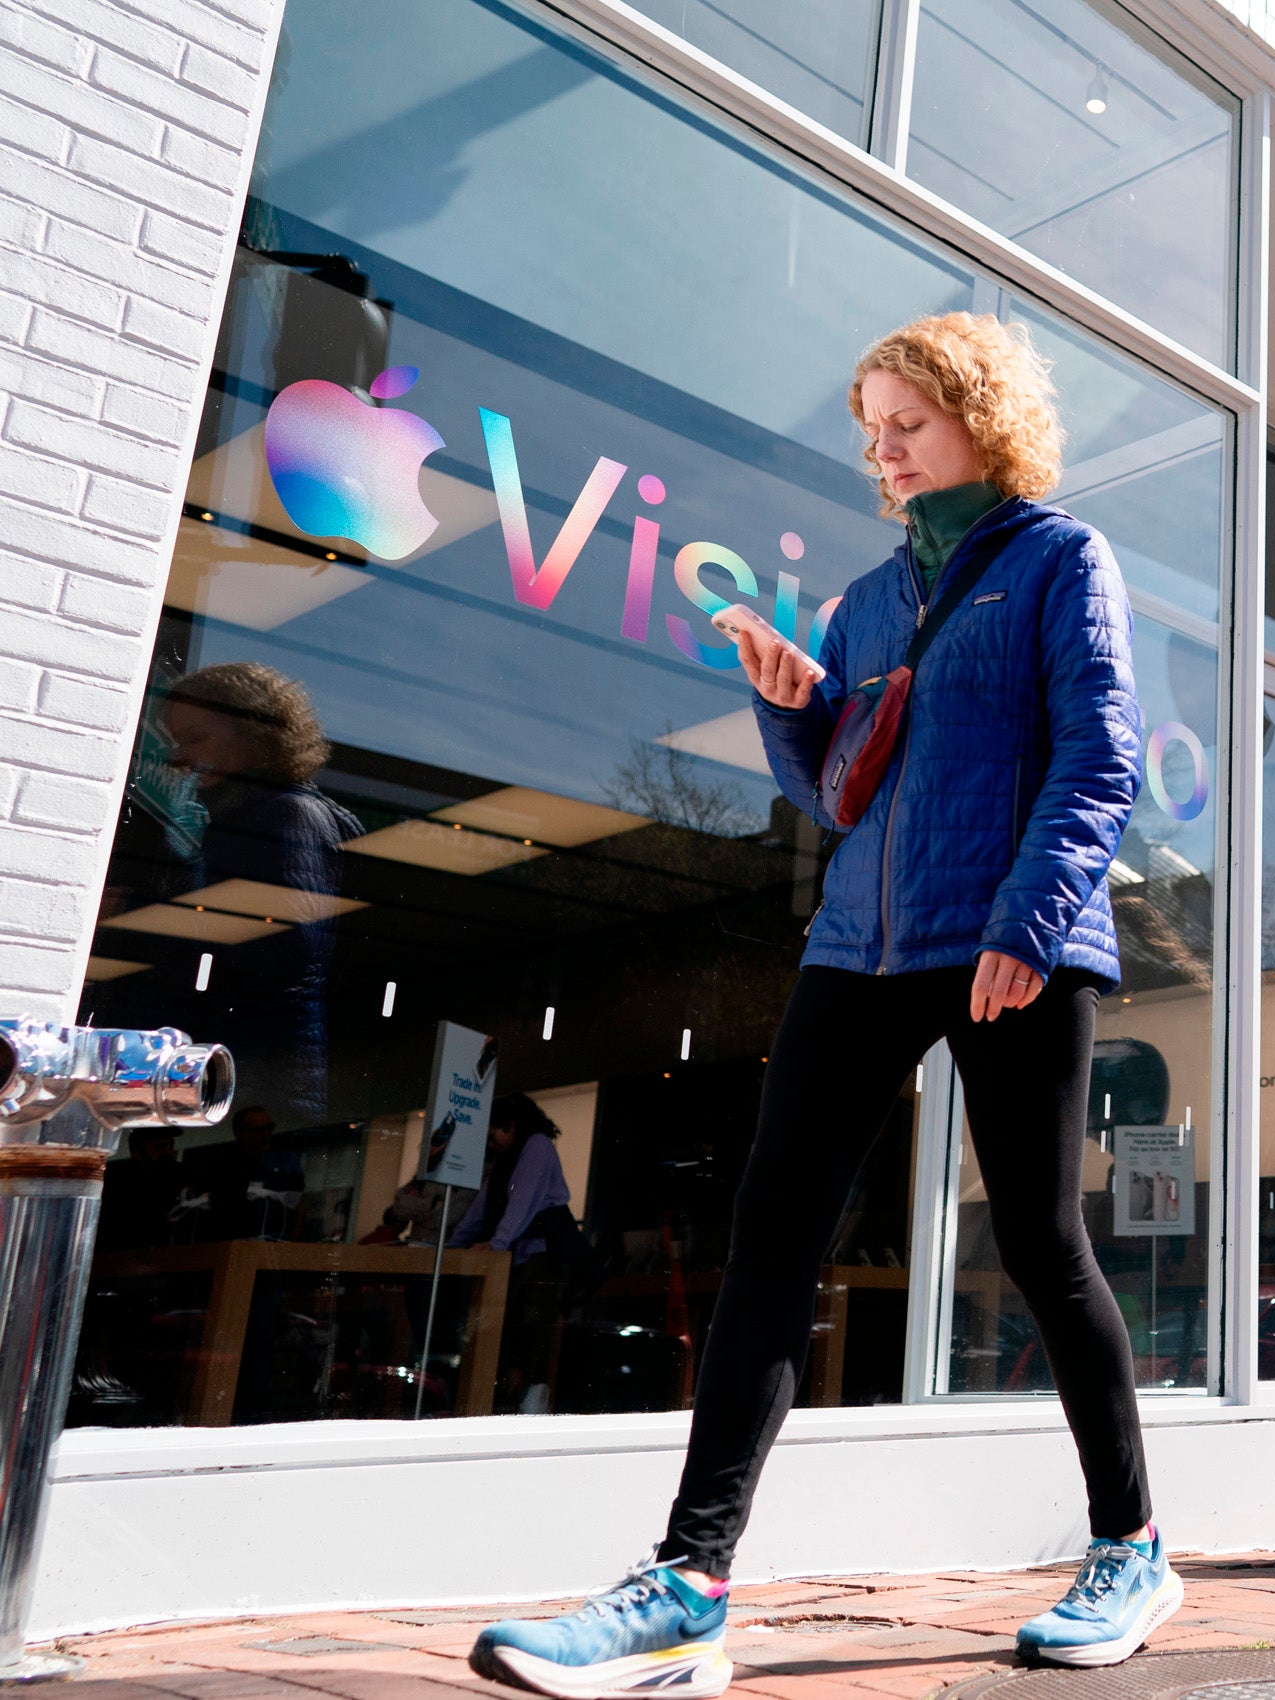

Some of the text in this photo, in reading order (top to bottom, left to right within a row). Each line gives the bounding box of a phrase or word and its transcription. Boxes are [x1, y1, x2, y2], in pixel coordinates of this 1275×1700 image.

[478, 406, 843, 670] Visi
[453, 1073, 473, 1090] Trade
[448, 1089, 481, 1110] Upgrade.
[453, 1108, 472, 1126] Save.
